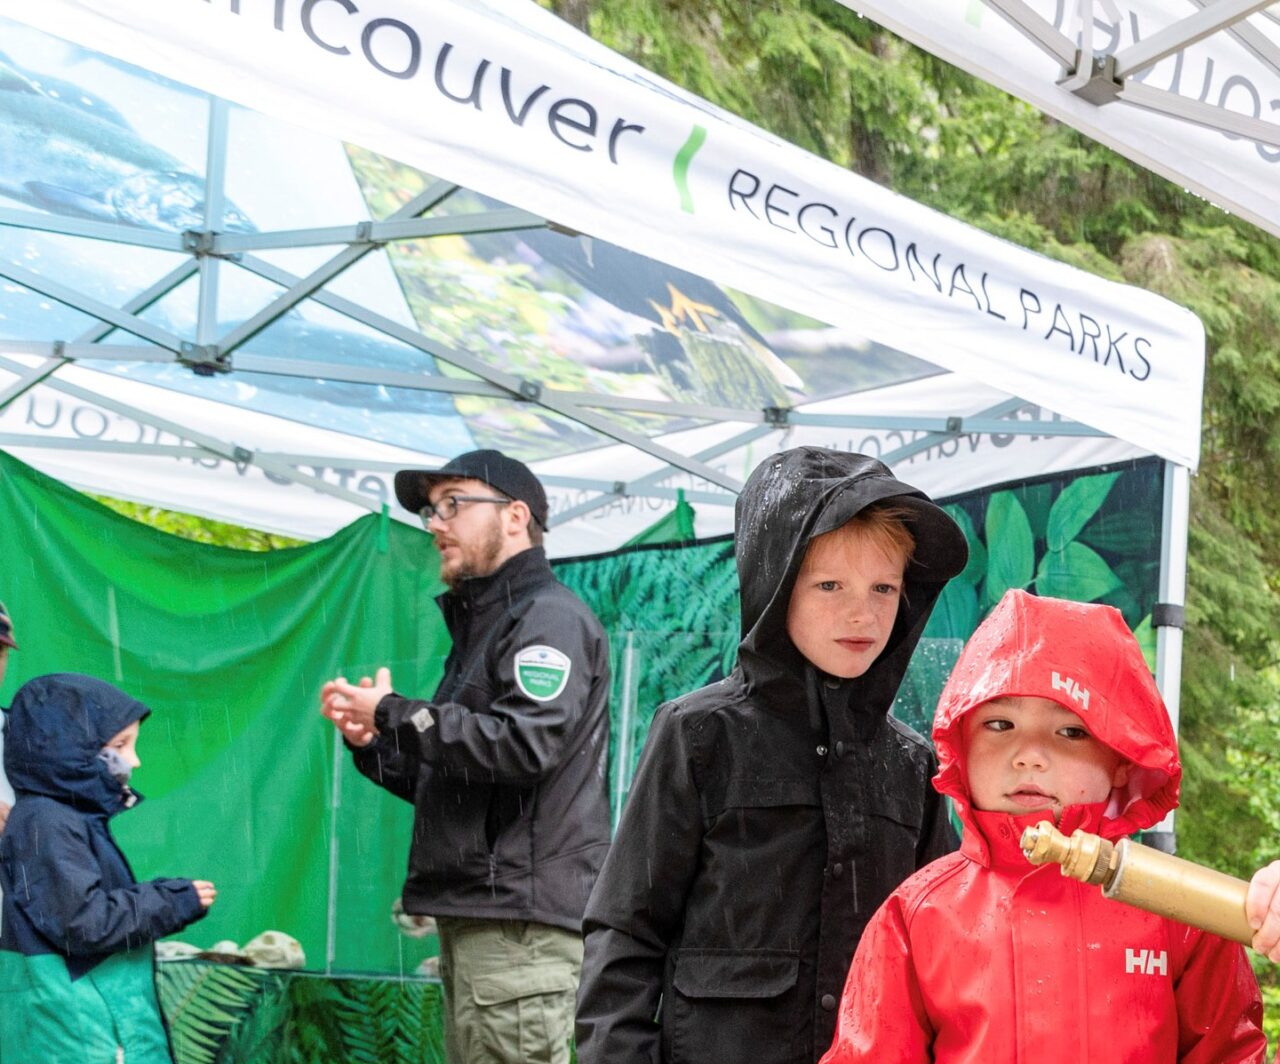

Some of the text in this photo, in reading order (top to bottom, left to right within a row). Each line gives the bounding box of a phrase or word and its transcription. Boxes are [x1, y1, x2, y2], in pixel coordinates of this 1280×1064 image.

[727, 168, 1153, 382] REGIONAL PARKS
[1051, 671, 1090, 711] HH
[1125, 948, 1168, 976] HH
